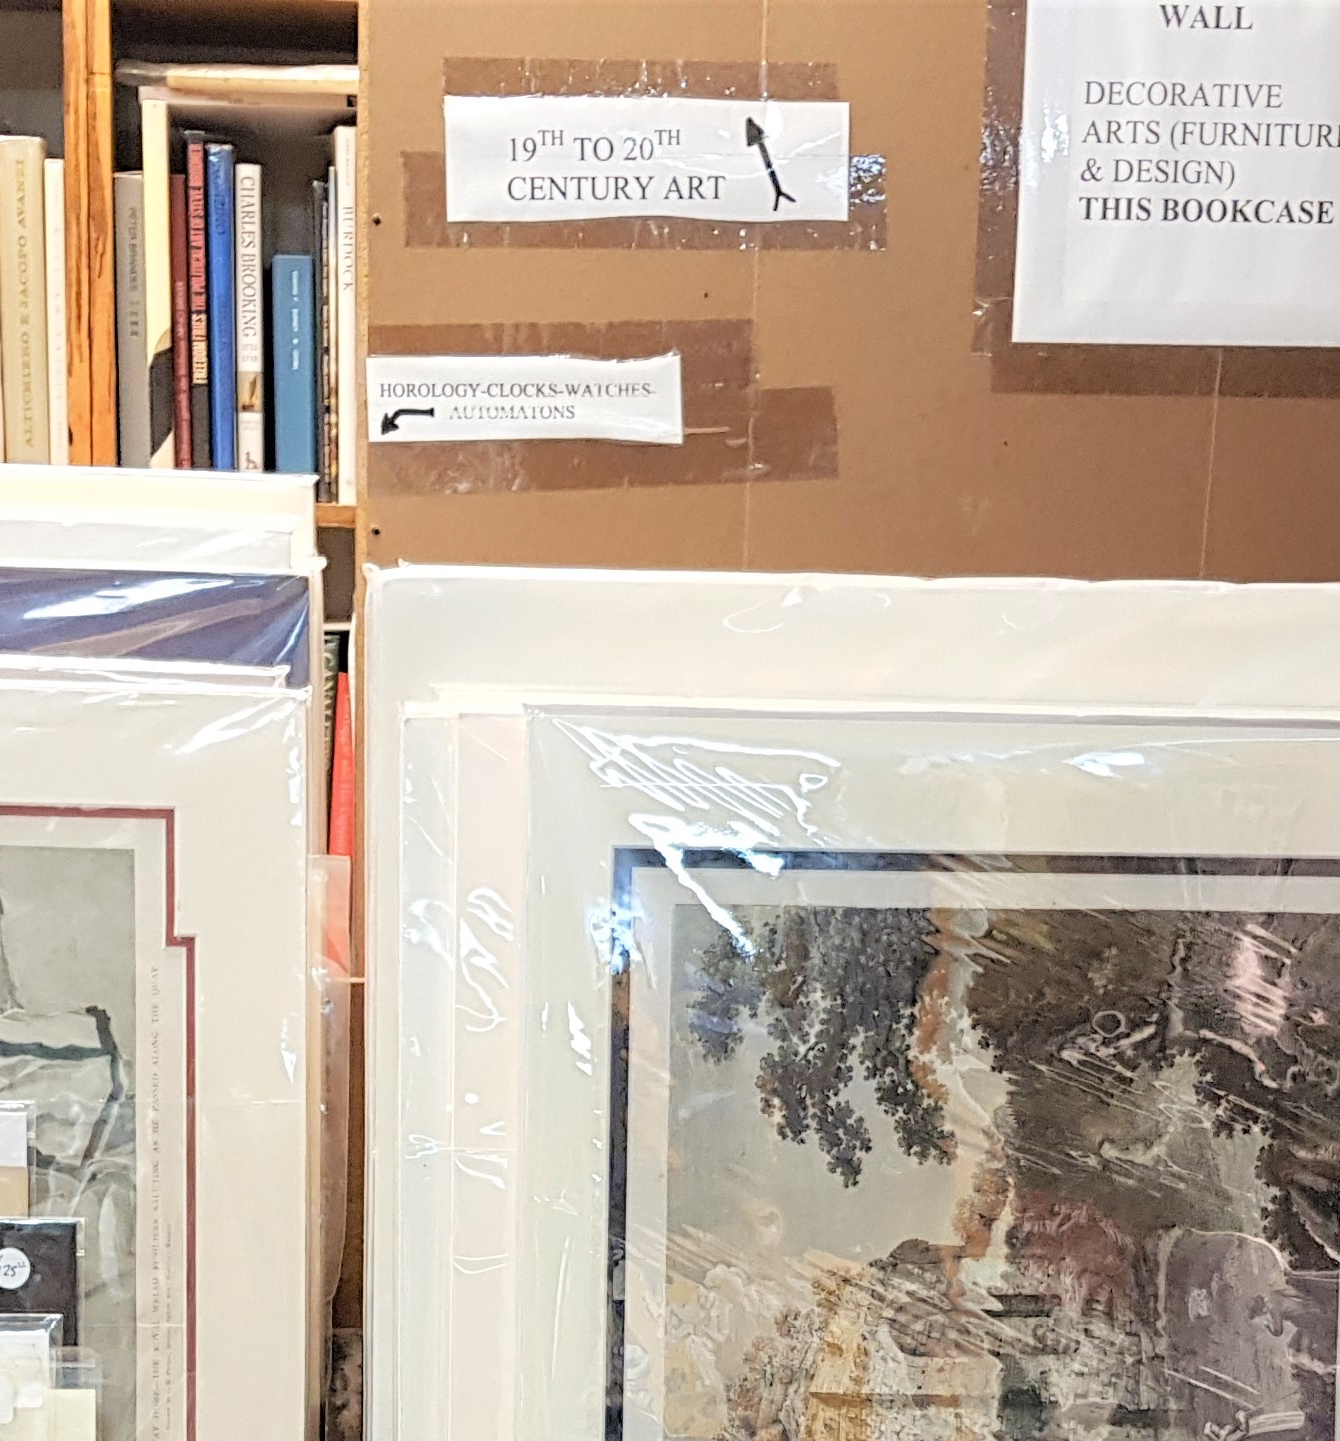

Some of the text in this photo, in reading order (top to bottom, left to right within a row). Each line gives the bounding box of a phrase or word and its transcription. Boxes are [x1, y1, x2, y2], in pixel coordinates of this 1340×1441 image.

[1161, 4, 1254, 31] WALL
[1084, 80, 1284, 110] DECORATIVE
[1081, 119, 1161, 147] ARTS
[573, 135, 615, 162] TO
[506, 174, 727, 203] CENTURY ART
[1079, 157, 1237, 190] & DESIGN)
[1078, 195, 1336, 226] THIS BOOKCASE
[240, 175, 258, 338] CHARLES BROOKING
[341, 205, 355, 291] BURDOCK
[18, 236, 30, 309] JACOPO
[191, 341, 208, 384] FREEDOM
[448, 403, 576, 422] AUTOMATONS
[151, 965, 160, 996] QUAY
[151, 1003, 160, 1023] THE
[151, 1031, 160, 1066] ALONG
[151, 1072, 160, 1112] PASSED
[151, 1119, 160, 1133] HE
[151, 1140, 160, 1154] AS
